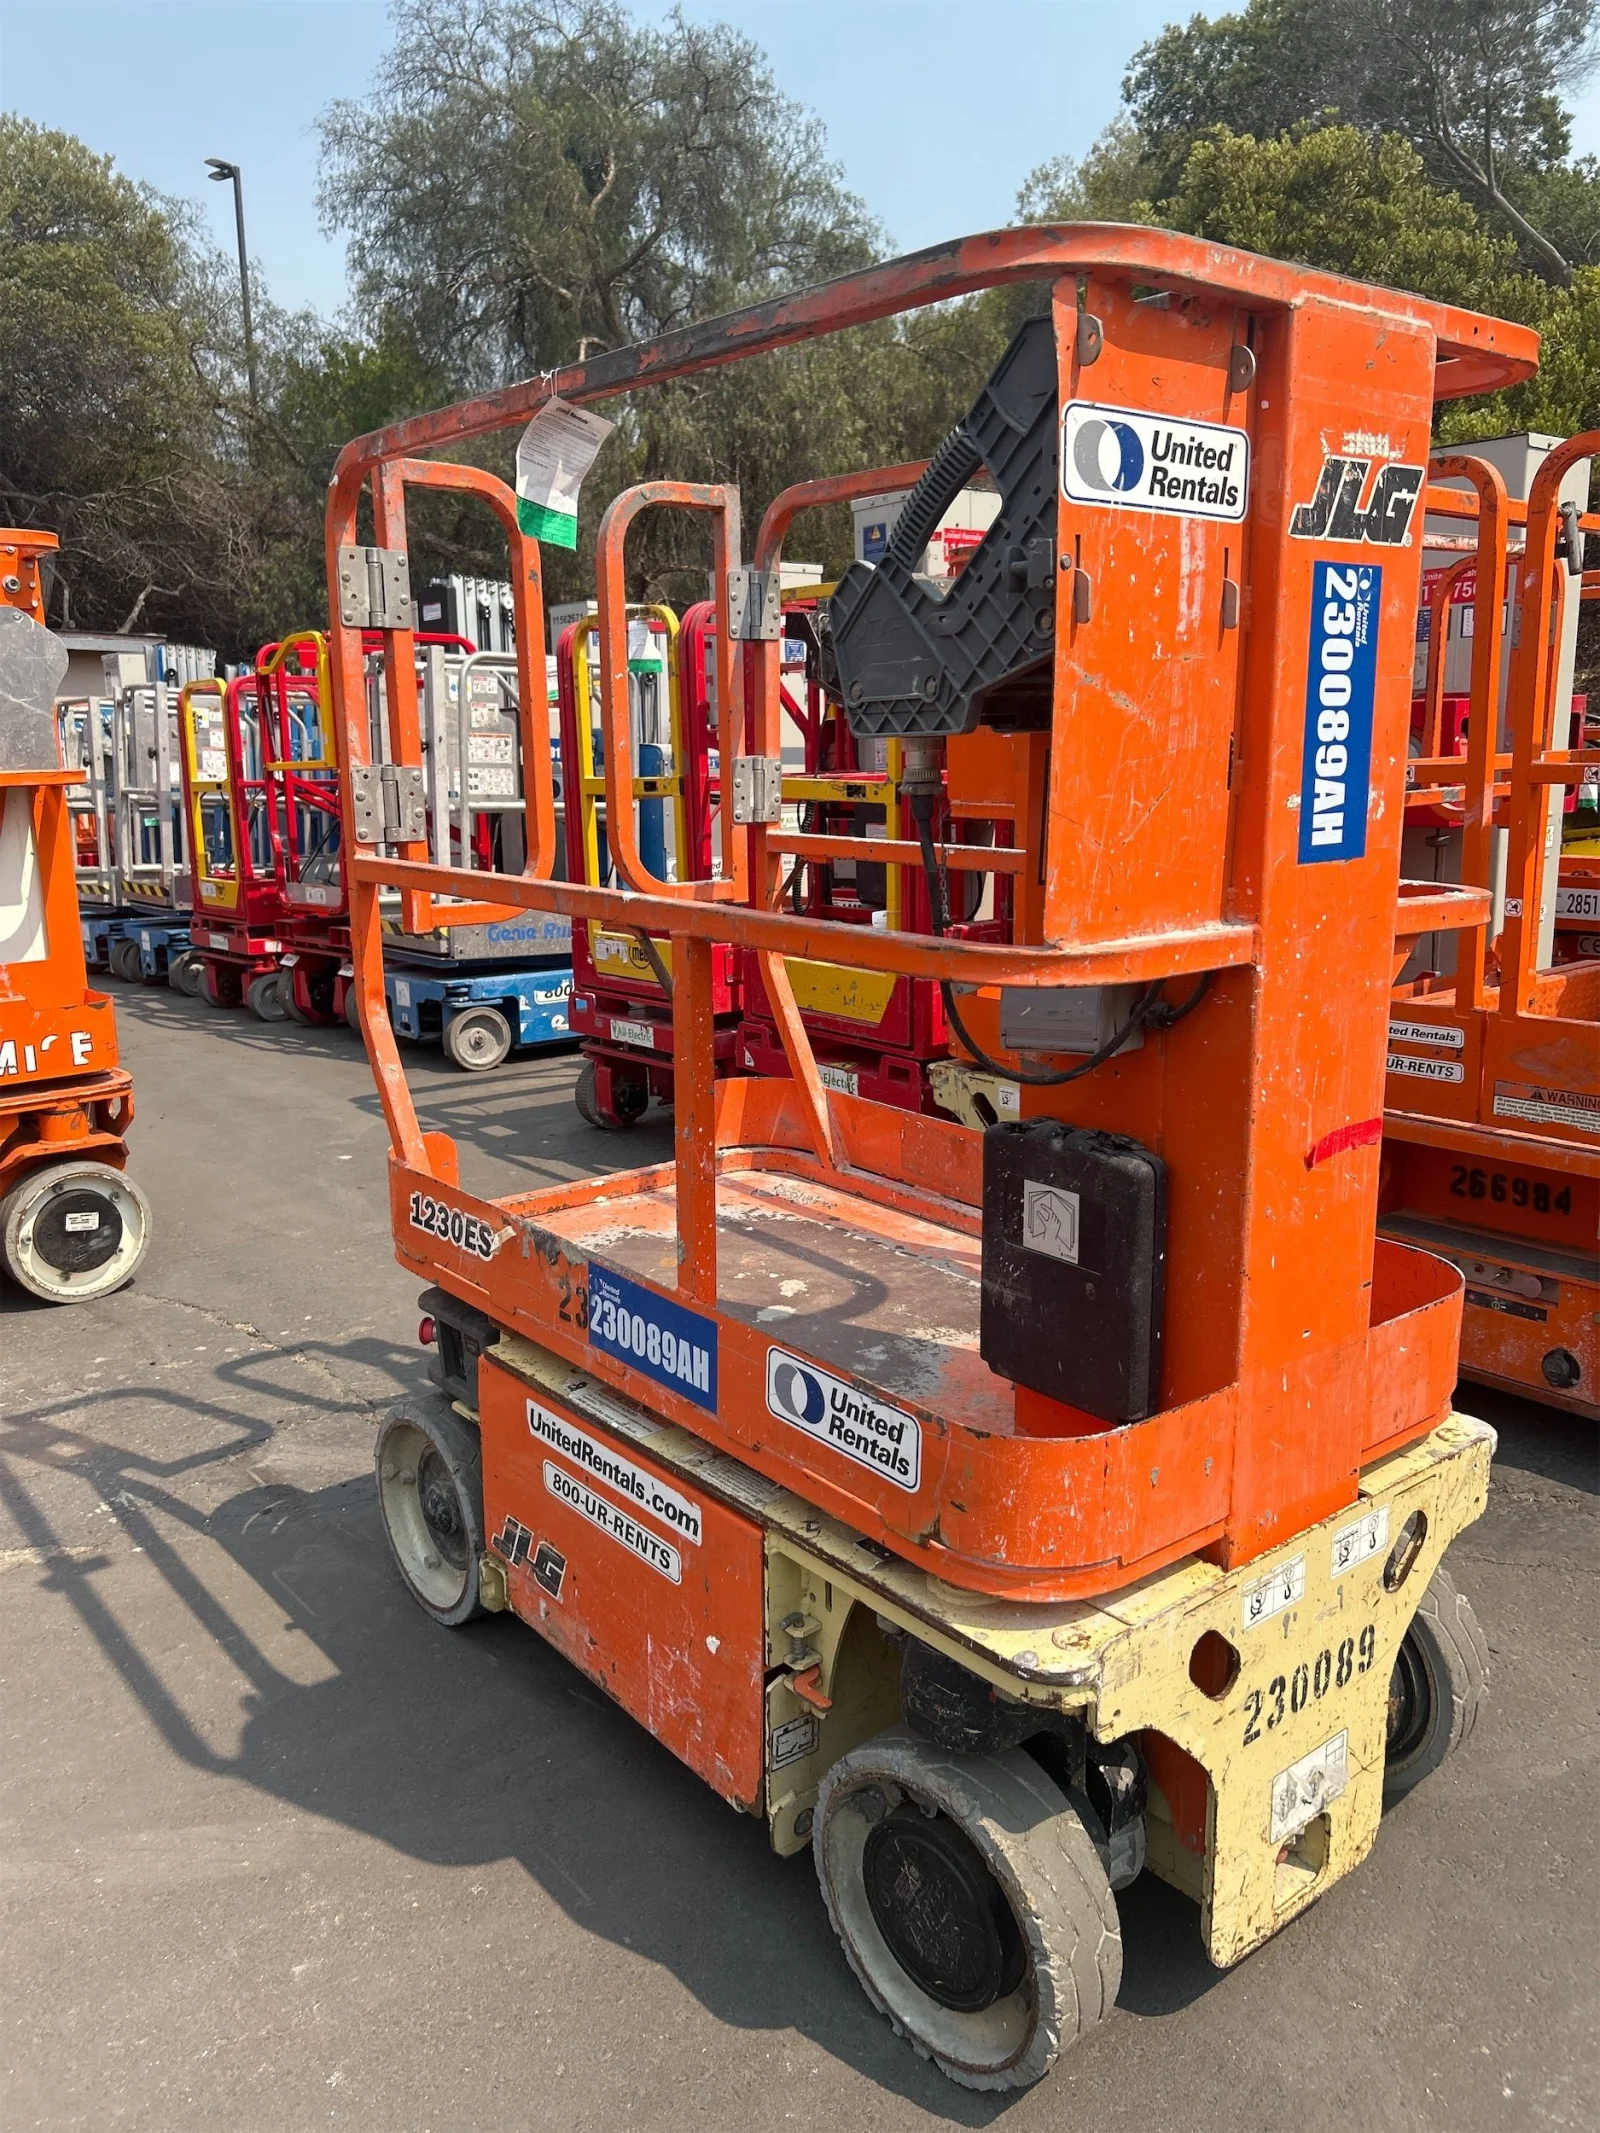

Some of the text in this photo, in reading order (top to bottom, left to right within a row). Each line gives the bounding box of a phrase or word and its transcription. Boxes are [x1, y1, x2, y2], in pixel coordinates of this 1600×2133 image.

[1150, 430, 1234, 472] United
[1148, 465, 1239, 507] Rentals
[1288, 456, 1425, 546] JLG
[1311, 567, 1358, 846] 230089AH
[487, 924, 537, 942] Genie
[1389, 1025, 1456, 1042] ted Rentals
[1386, 1058, 1454, 1078] UR-RENTS
[1450, 1164, 1572, 1216] 266984
[411, 1193, 493, 1259] 1230ES
[590, 1294, 710, 1394] 230089AH
[828, 1413, 911, 1477] Rentals
[830, 1387, 905, 1445] United
[529, 1408, 699, 1538] UnitedRentals.com
[552, 1472, 672, 1571] 800-UR-RENTS
[491, 1514, 568, 1601] JLG
[1243, 1624, 1376, 1748] 230089
